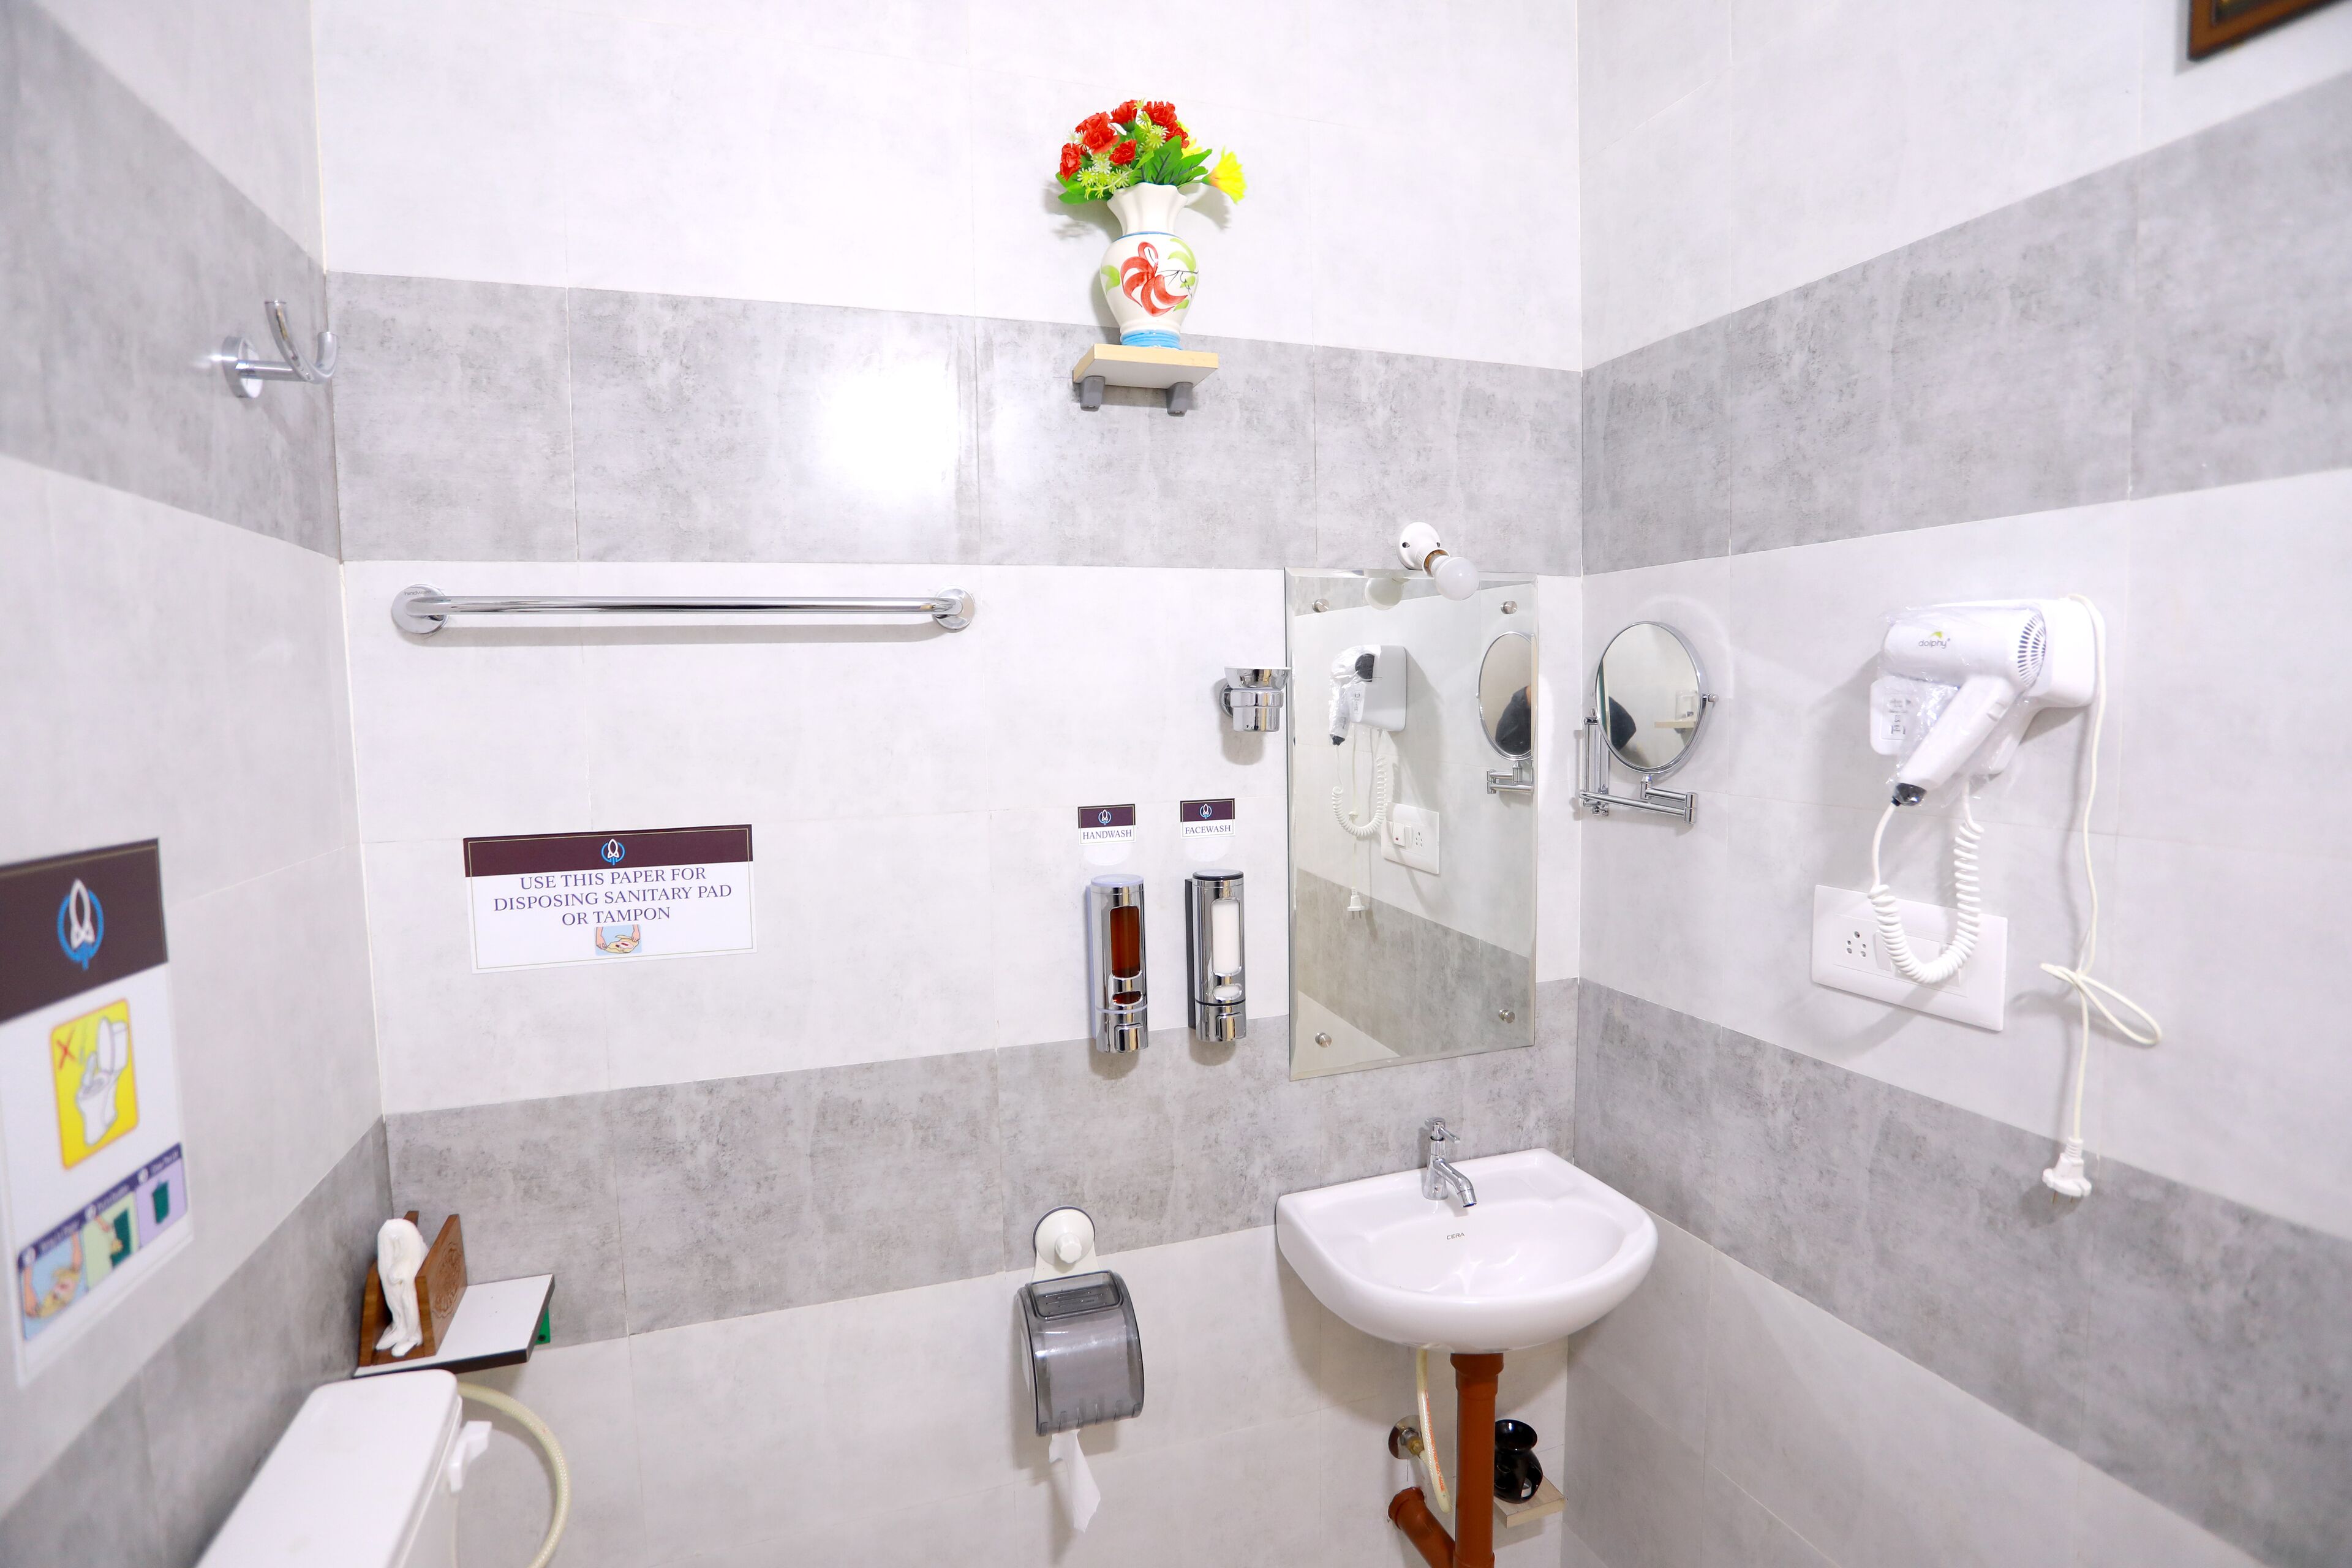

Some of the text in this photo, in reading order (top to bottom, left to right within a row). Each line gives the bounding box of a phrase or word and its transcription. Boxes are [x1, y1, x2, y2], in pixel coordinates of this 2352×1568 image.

[1082, 829, 1132, 840] HANDWASH
[1185, 824, 1231, 834] FACEWASH
[519, 867, 706, 890] USE THIS PAPER FOR
[494, 884, 732, 911] DISPOSING SANITARY PAD
[562, 907, 670, 926] OR TAMPON
